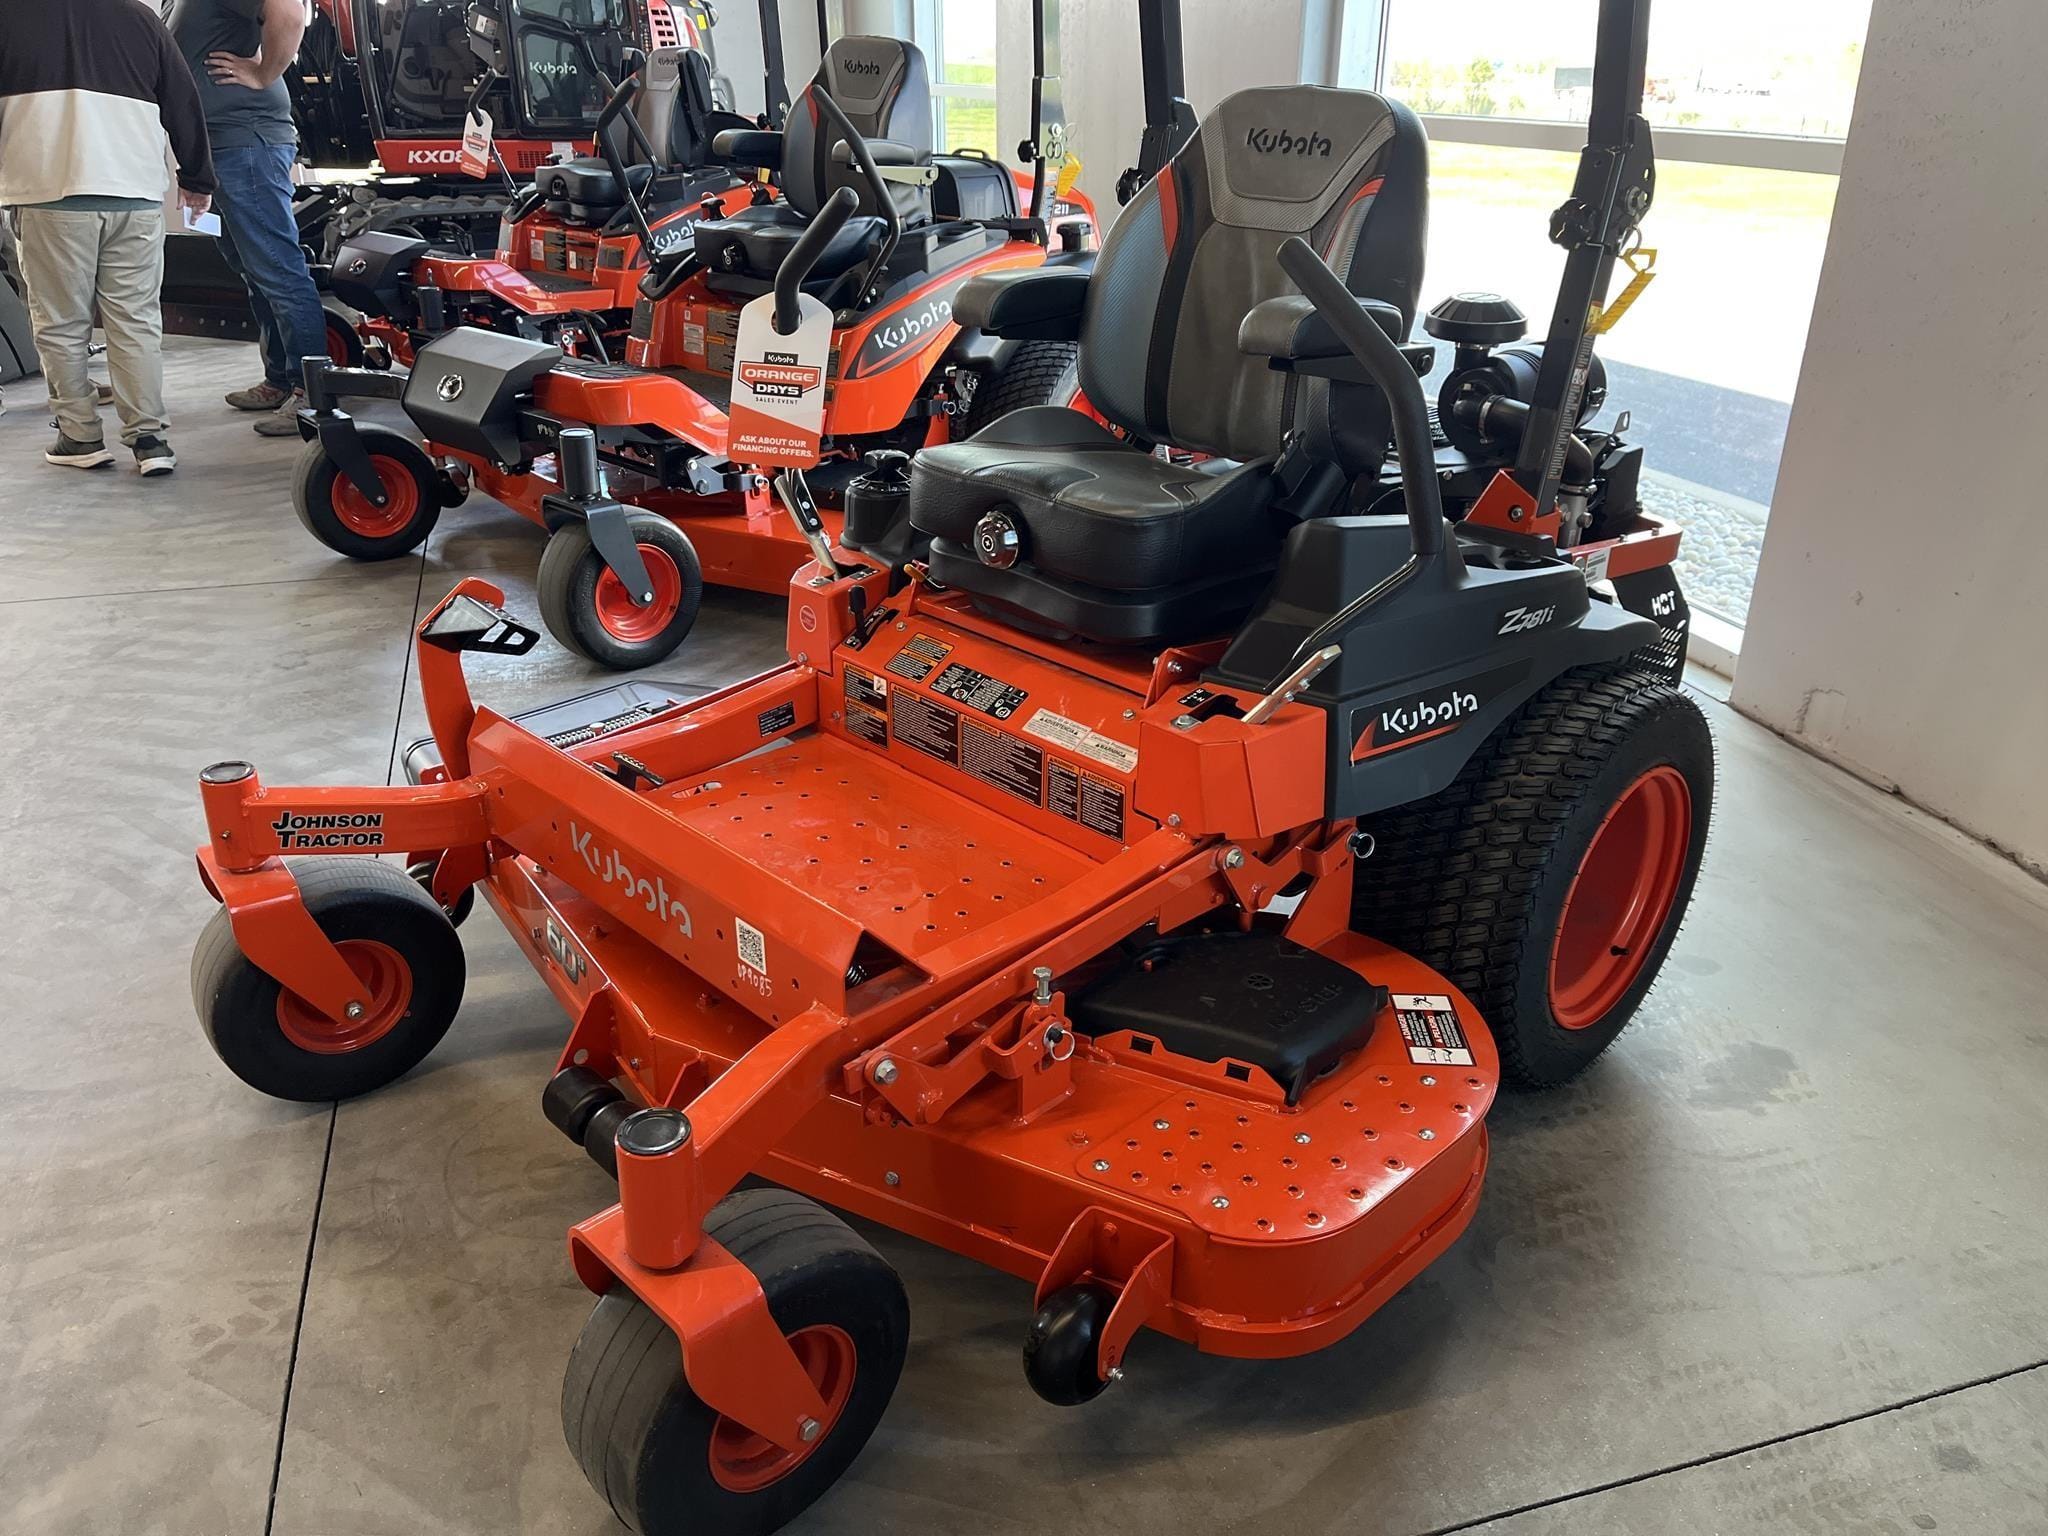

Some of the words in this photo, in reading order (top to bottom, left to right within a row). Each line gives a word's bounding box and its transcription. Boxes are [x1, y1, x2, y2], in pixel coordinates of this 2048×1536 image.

[529, 61, 578, 75] Kubota
[844, 58, 880, 76] Kubota
[1246, 127, 1332, 157] Kubota
[874, 300, 952, 349] Kubota
[767, 354, 794, 364] Kubota
[744, 368, 815, 382] ORANGE
[756, 383, 799, 395] DAYS
[777, 398, 798, 406] EVENT
[740, 434, 757, 443] ASK
[758, 436, 787, 447] ABOUT
[788, 439, 807, 448] OUR
[732, 443, 778, 455] FINANCING
[779, 447, 814, 458] OFFERS.
[1651, 590, 1676, 617] HOT
[1381, 690, 1479, 734] Kubota
[271, 811, 383, 830] JOHNSON
[276, 830, 385, 849] TRACTOR
[569, 821, 693, 939] Kubota
